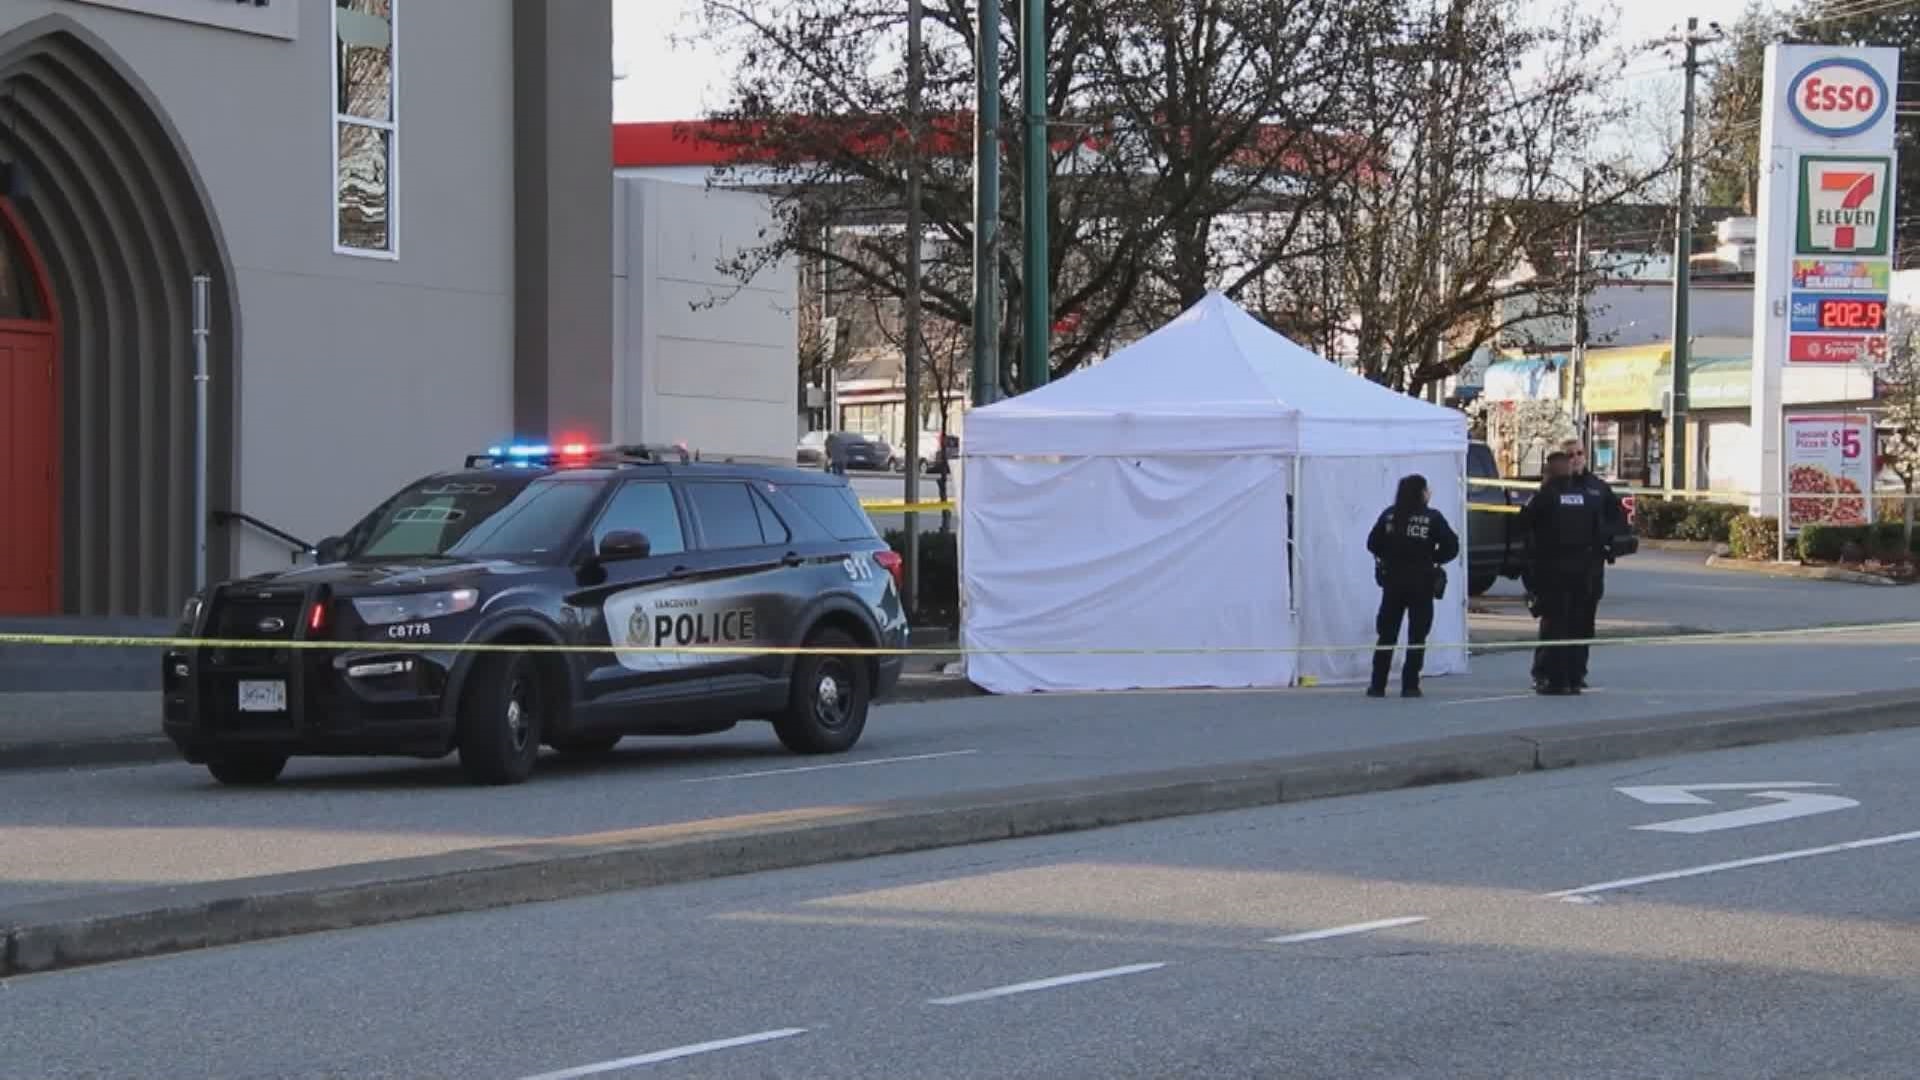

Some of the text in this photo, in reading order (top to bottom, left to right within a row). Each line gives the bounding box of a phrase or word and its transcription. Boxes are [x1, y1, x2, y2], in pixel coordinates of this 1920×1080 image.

[1805, 77, 1874, 112] Esso
[1823, 302, 1881, 327] 202.9
[1831, 430, 1861, 458] $5
[843, 559, 873, 580] 911
[655, 611, 753, 647] POLICE
